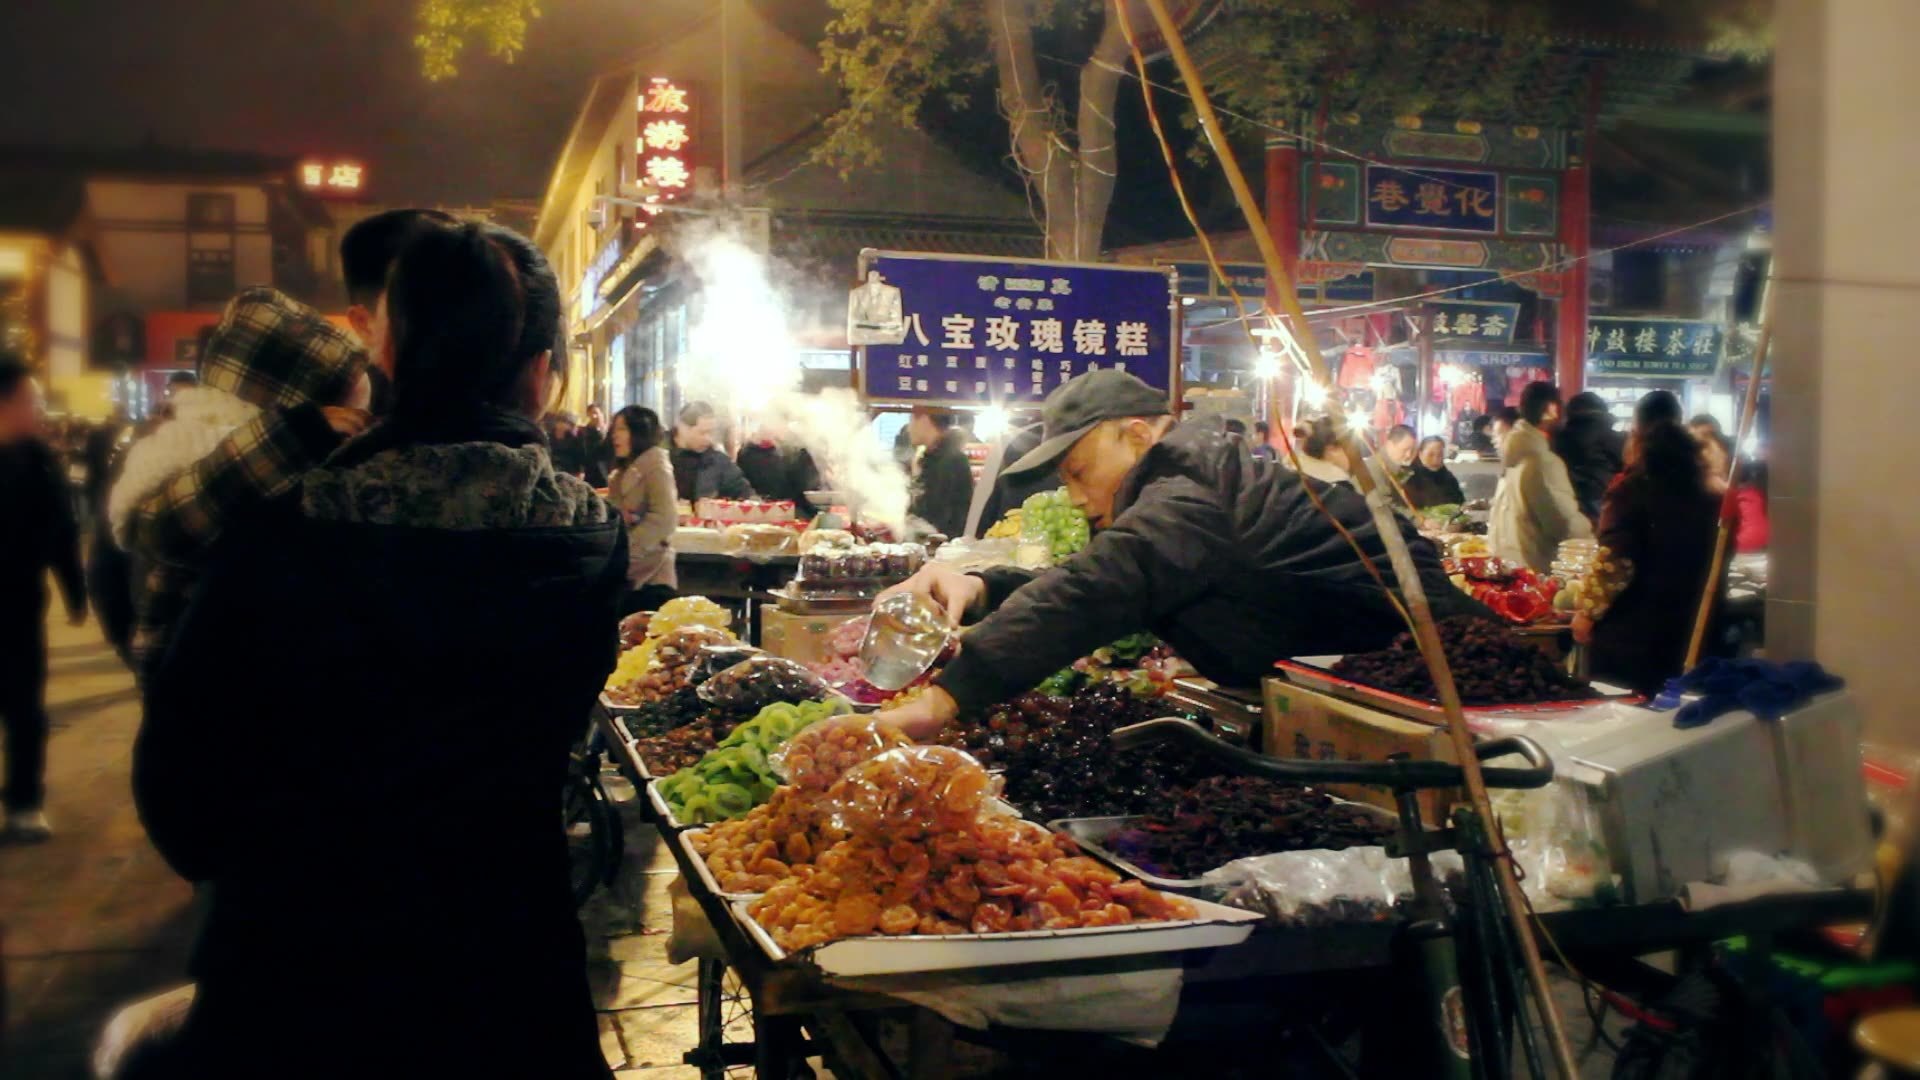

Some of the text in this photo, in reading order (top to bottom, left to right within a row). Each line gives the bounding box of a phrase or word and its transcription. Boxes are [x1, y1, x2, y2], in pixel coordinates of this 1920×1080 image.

[903, 314, 1149, 355] 八宝玫瑰镜糕
[1480, 354, 1521, 366] SHOP
